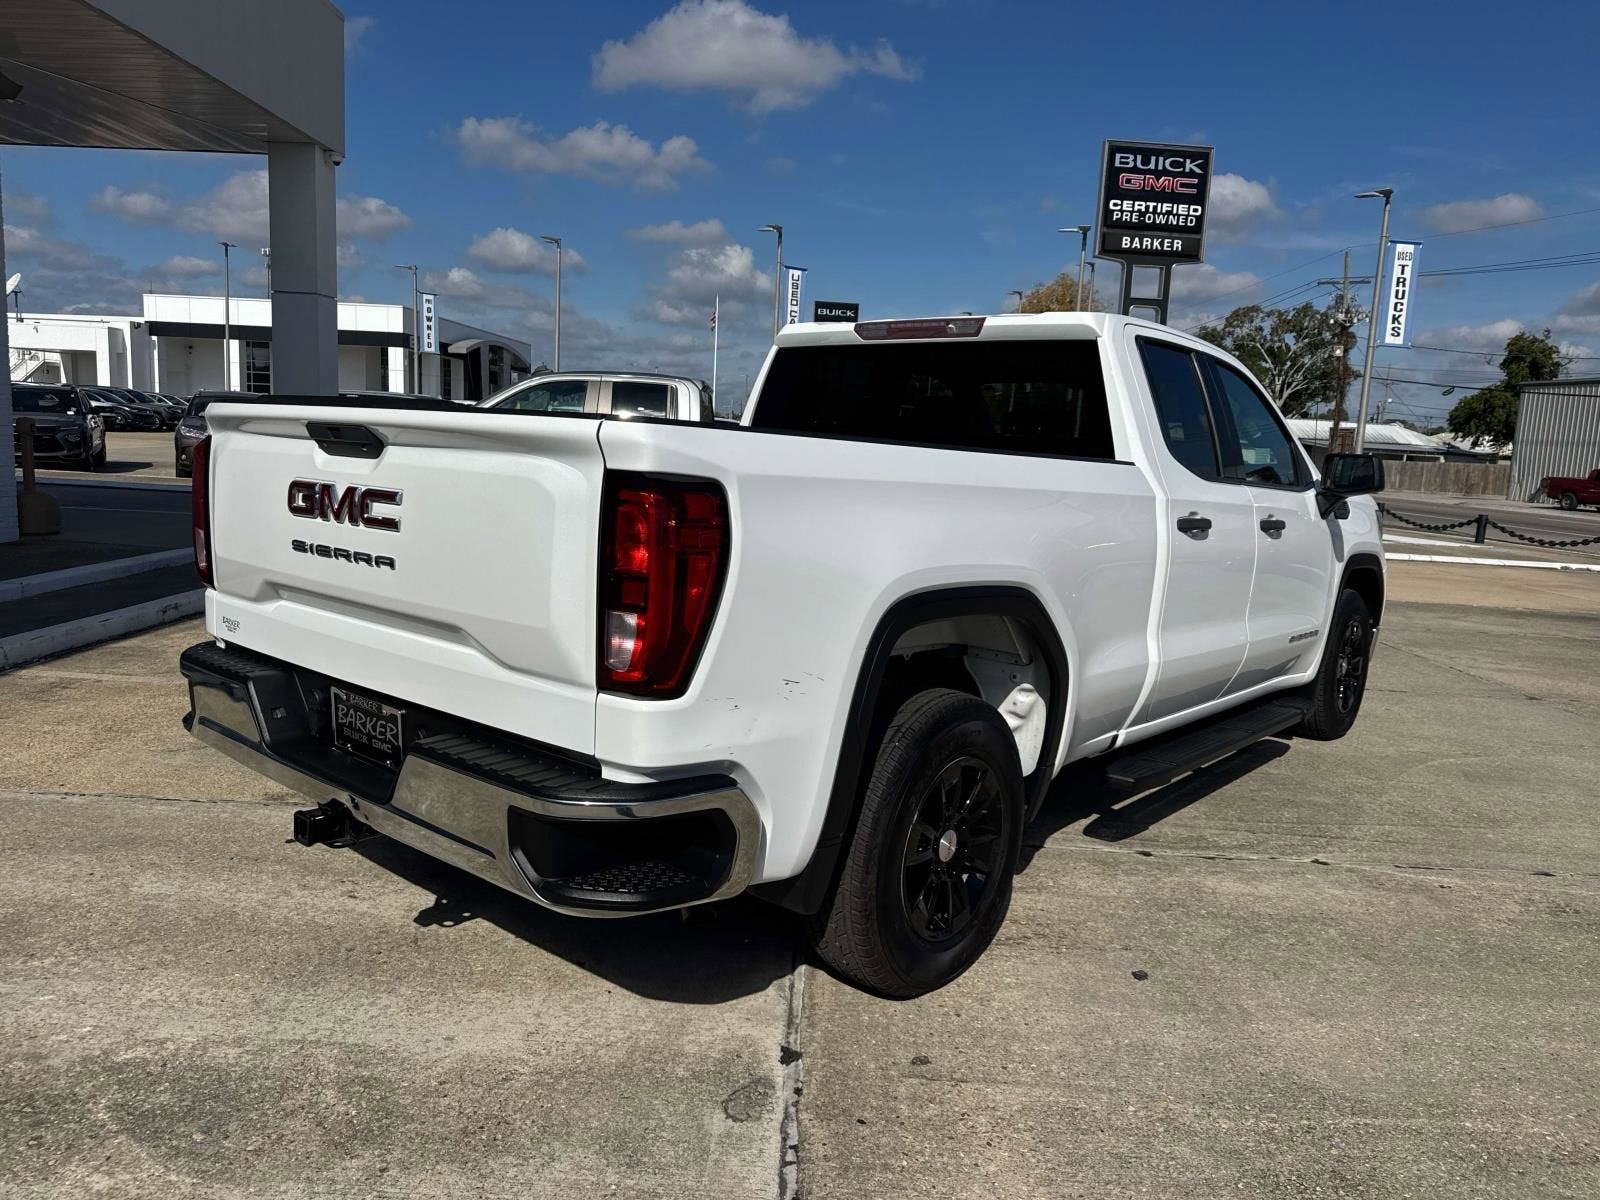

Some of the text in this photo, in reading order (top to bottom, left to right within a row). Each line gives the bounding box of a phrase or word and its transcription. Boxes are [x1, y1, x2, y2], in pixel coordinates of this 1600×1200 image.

[1114, 153, 1204, 174] BUICK
[1119, 173, 1198, 194] GMC
[1109, 199, 1202, 216] CERTIFIED
[1112, 211, 1196, 226] PRE-OWNED
[1121, 236, 1182, 251] BARKER
[1397, 251, 1413, 261] USED
[1390, 264, 1409, 338] TRUCKS
[817, 308, 855, 317] BUICK
[425, 306, 433, 349] OWNED
[287, 477, 403, 533] GMC
[291, 539, 396, 571] SIERRA
[337, 704, 399, 746] BARKER
[343, 727, 392, 753] BUICK GMC
